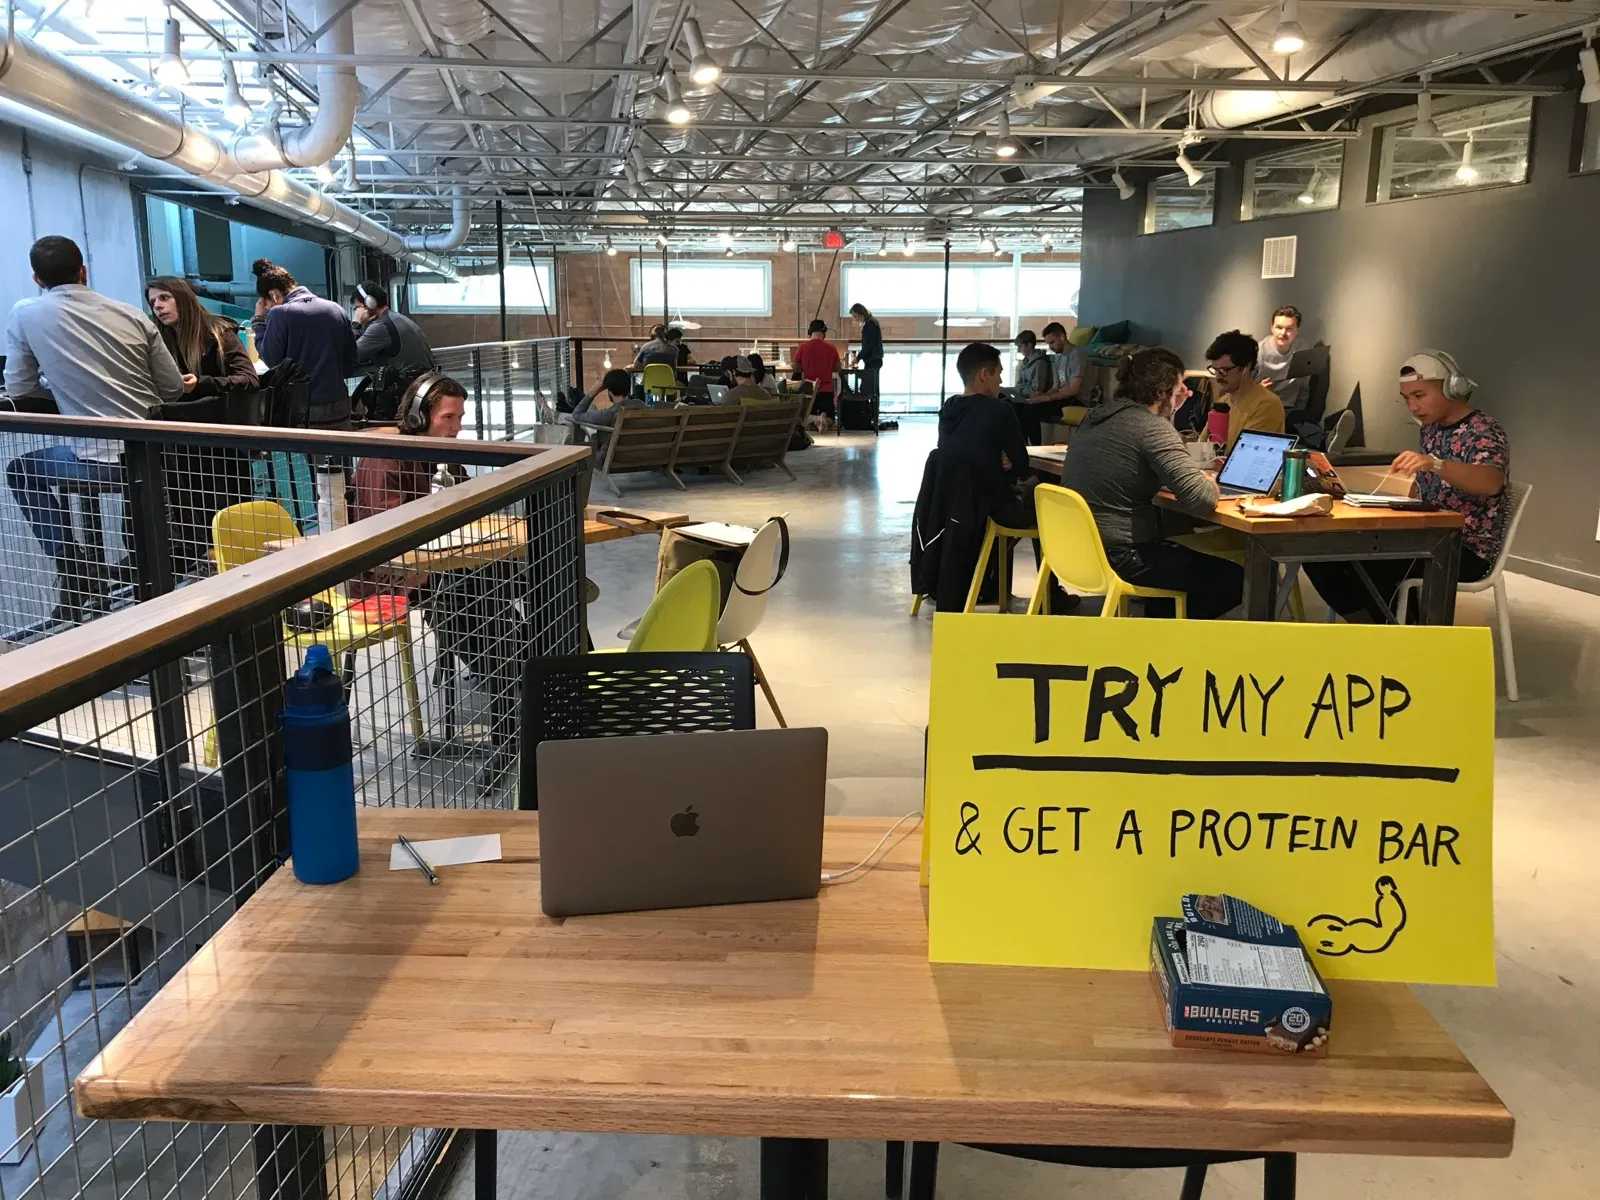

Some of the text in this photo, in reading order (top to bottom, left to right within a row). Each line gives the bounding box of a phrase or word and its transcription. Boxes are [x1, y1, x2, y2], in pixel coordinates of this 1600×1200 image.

[996, 663, 1411, 744] TRY MY APP
[956, 802, 1460, 866] & GET A PROTEIN BAR
[1190, 1006, 1260, 1023] BUILDERS
[1205, 1018, 1243, 1026] PROTEIN
[1288, 1013, 1304, 1022] 20
